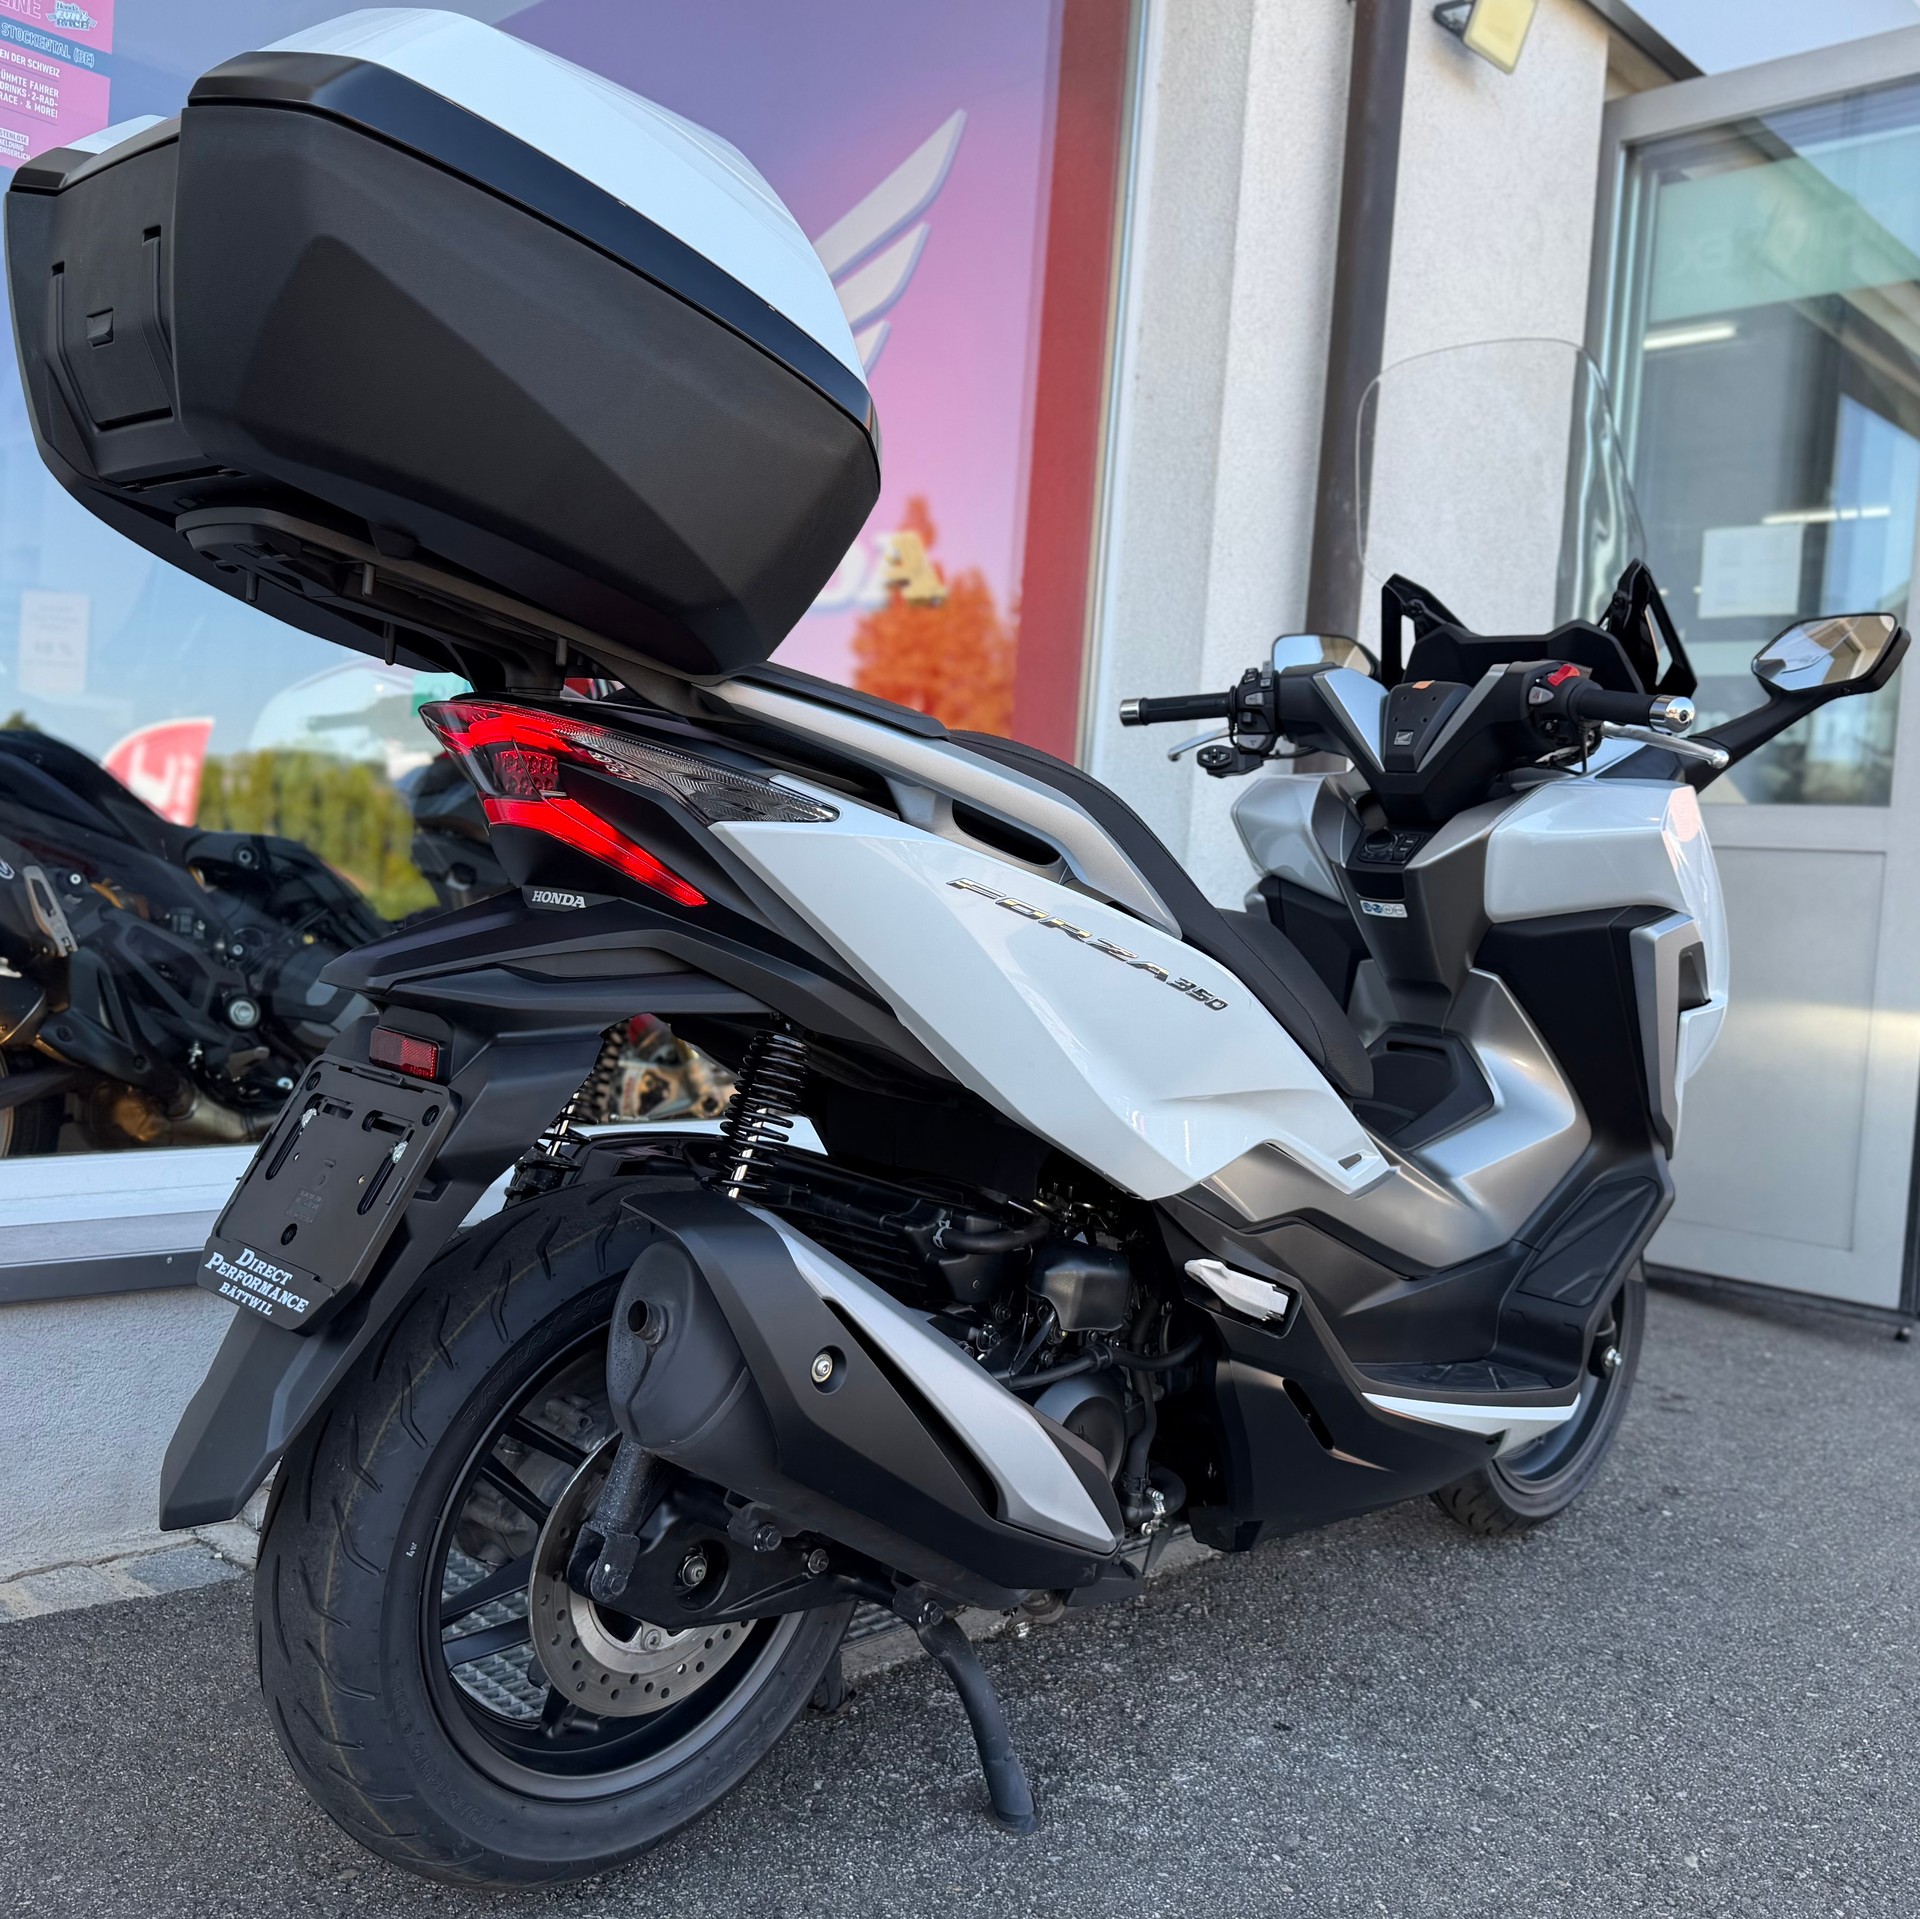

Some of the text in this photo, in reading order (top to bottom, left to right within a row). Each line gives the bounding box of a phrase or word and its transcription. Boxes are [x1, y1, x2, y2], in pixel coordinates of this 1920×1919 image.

[1, 22, 71, 59] STOCKENTAL
[11, 52, 26, 66] DER
[27, 58, 61, 78] SCHWEIZ
[29, 80, 59, 99] FAHRER
[34, 102, 58, 119] MORE!
[531, 890, 586, 909] HONDA
[946, 878, 1229, 1011] FORZA 350
[204, 1252, 310, 1313] PERFORMANCE
[235, 1248, 293, 1286] DIRECT
[219, 1281, 273, 1316] BÄTTWIL
